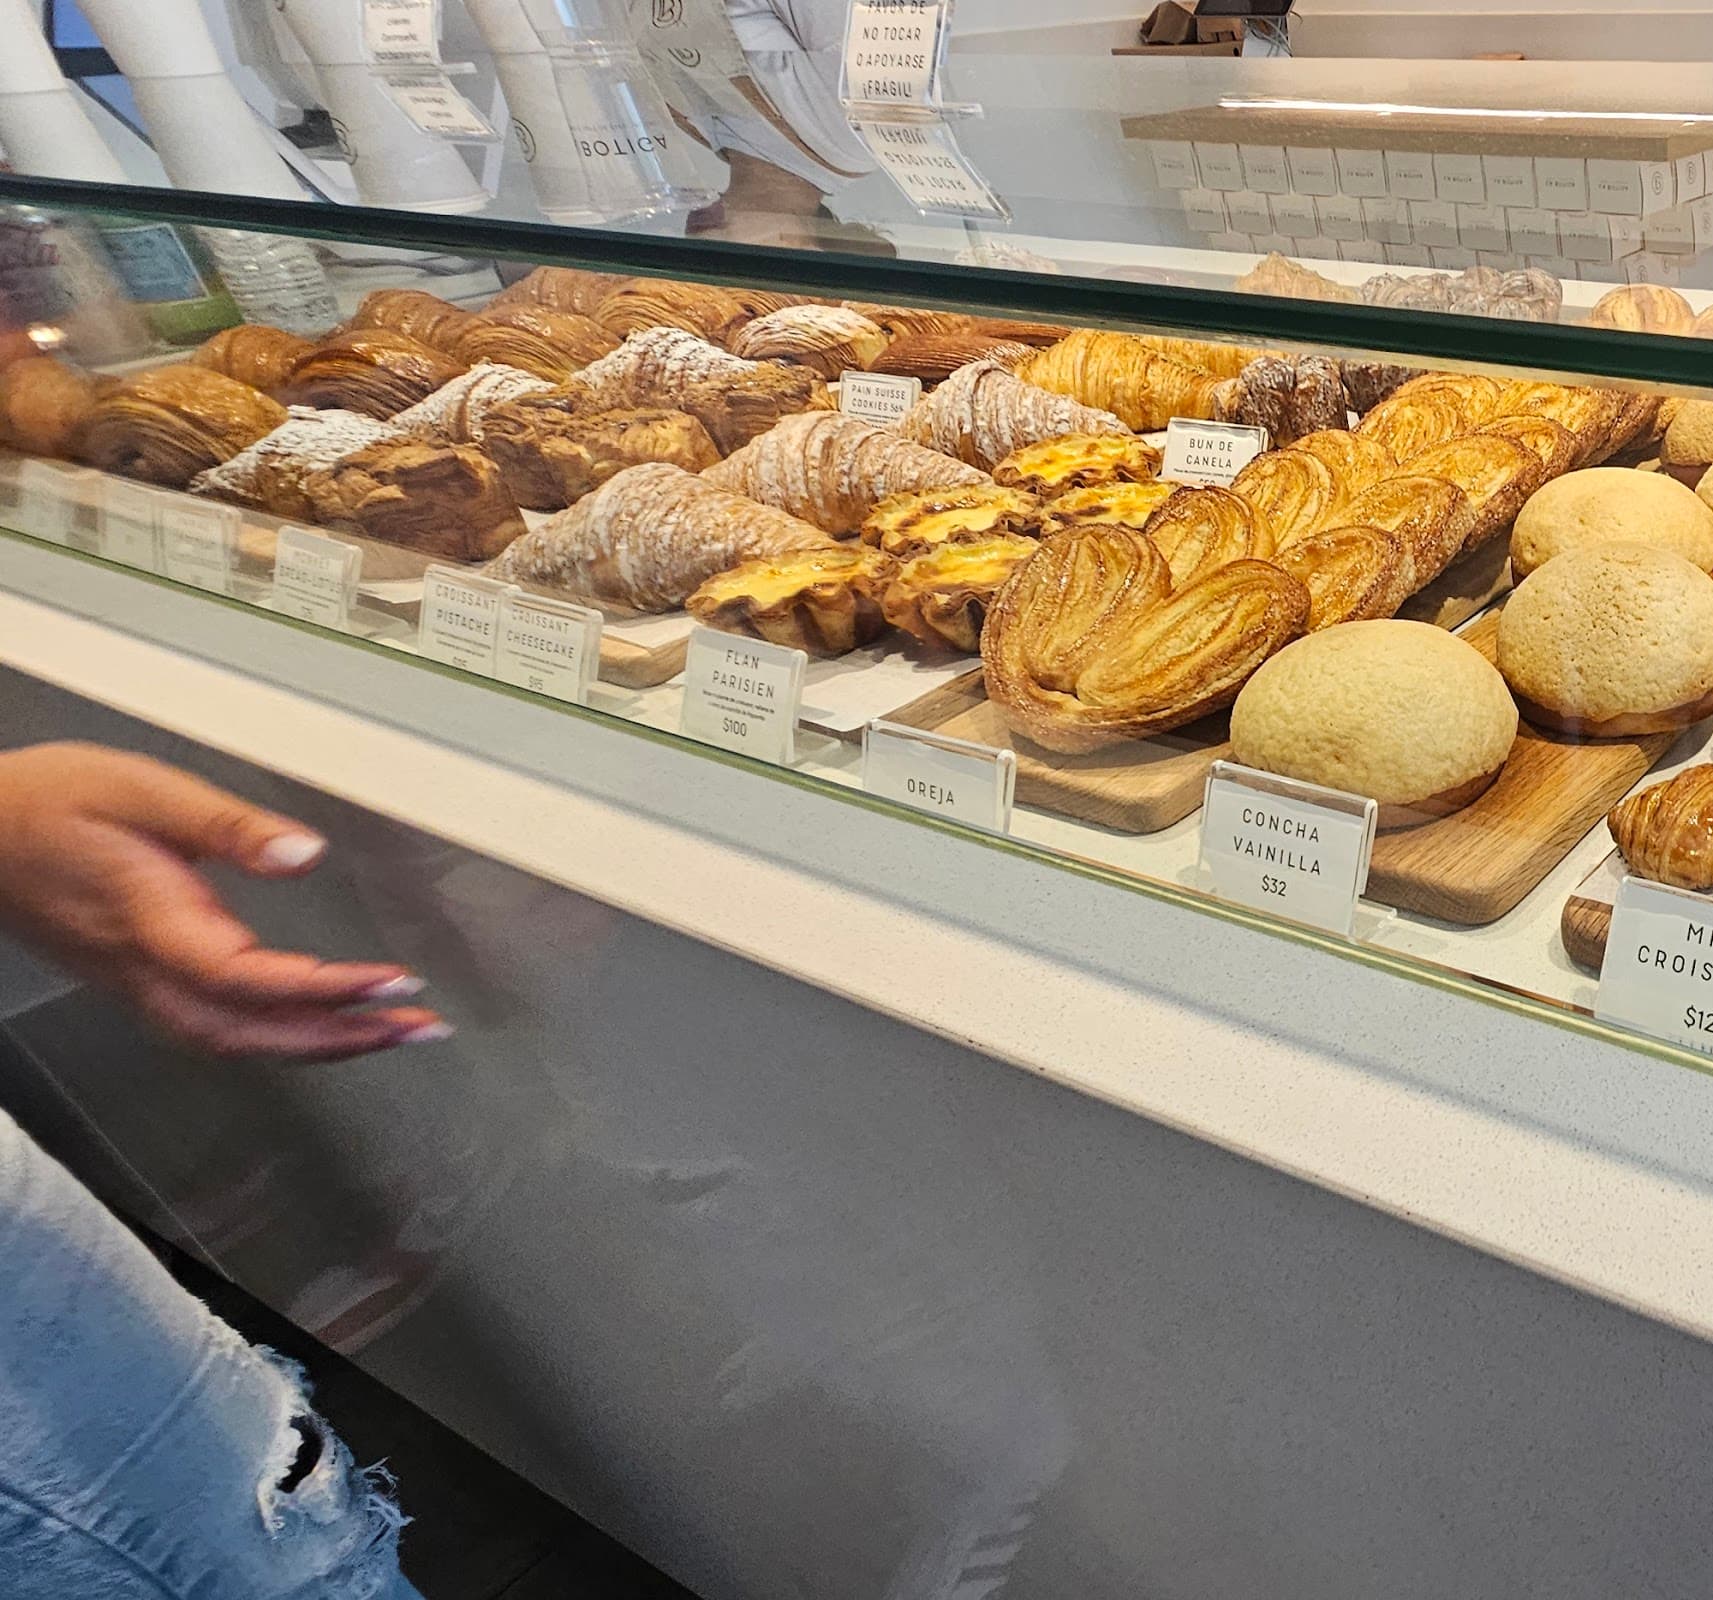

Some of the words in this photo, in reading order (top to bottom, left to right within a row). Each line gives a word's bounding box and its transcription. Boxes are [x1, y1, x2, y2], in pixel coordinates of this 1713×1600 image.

[863, 26, 879, 41] NO
[884, 26, 921, 41] TOCAR
[856, 53, 863, 67] O
[866, 53, 926, 69] APOYARSE
[851, 384, 872, 395] PAIN
[875, 388, 906, 400] SUISSE
[851, 398, 889, 412] COOKIES
[1189, 438, 1214, 450] BUN
[1218, 441, 1234, 452] DE
[1186, 454, 1233, 468] CANELA
[435, 583, 497, 613] CROISSANT
[436, 608, 490, 636] PISTACHE
[512, 608, 569, 635] CROISSANT
[506, 629, 574, 659] CHEESECAKE
[725, 649, 760, 669] FLAN
[712, 670, 775, 699] PARISIEN
[722, 717, 748, 737] $100
[907, 778, 955, 806] OREJA
[1242, 808, 1320, 843] CONCHA
[1233, 835, 1321, 876] VAINILLA
[1261, 874, 1288, 897] $32
